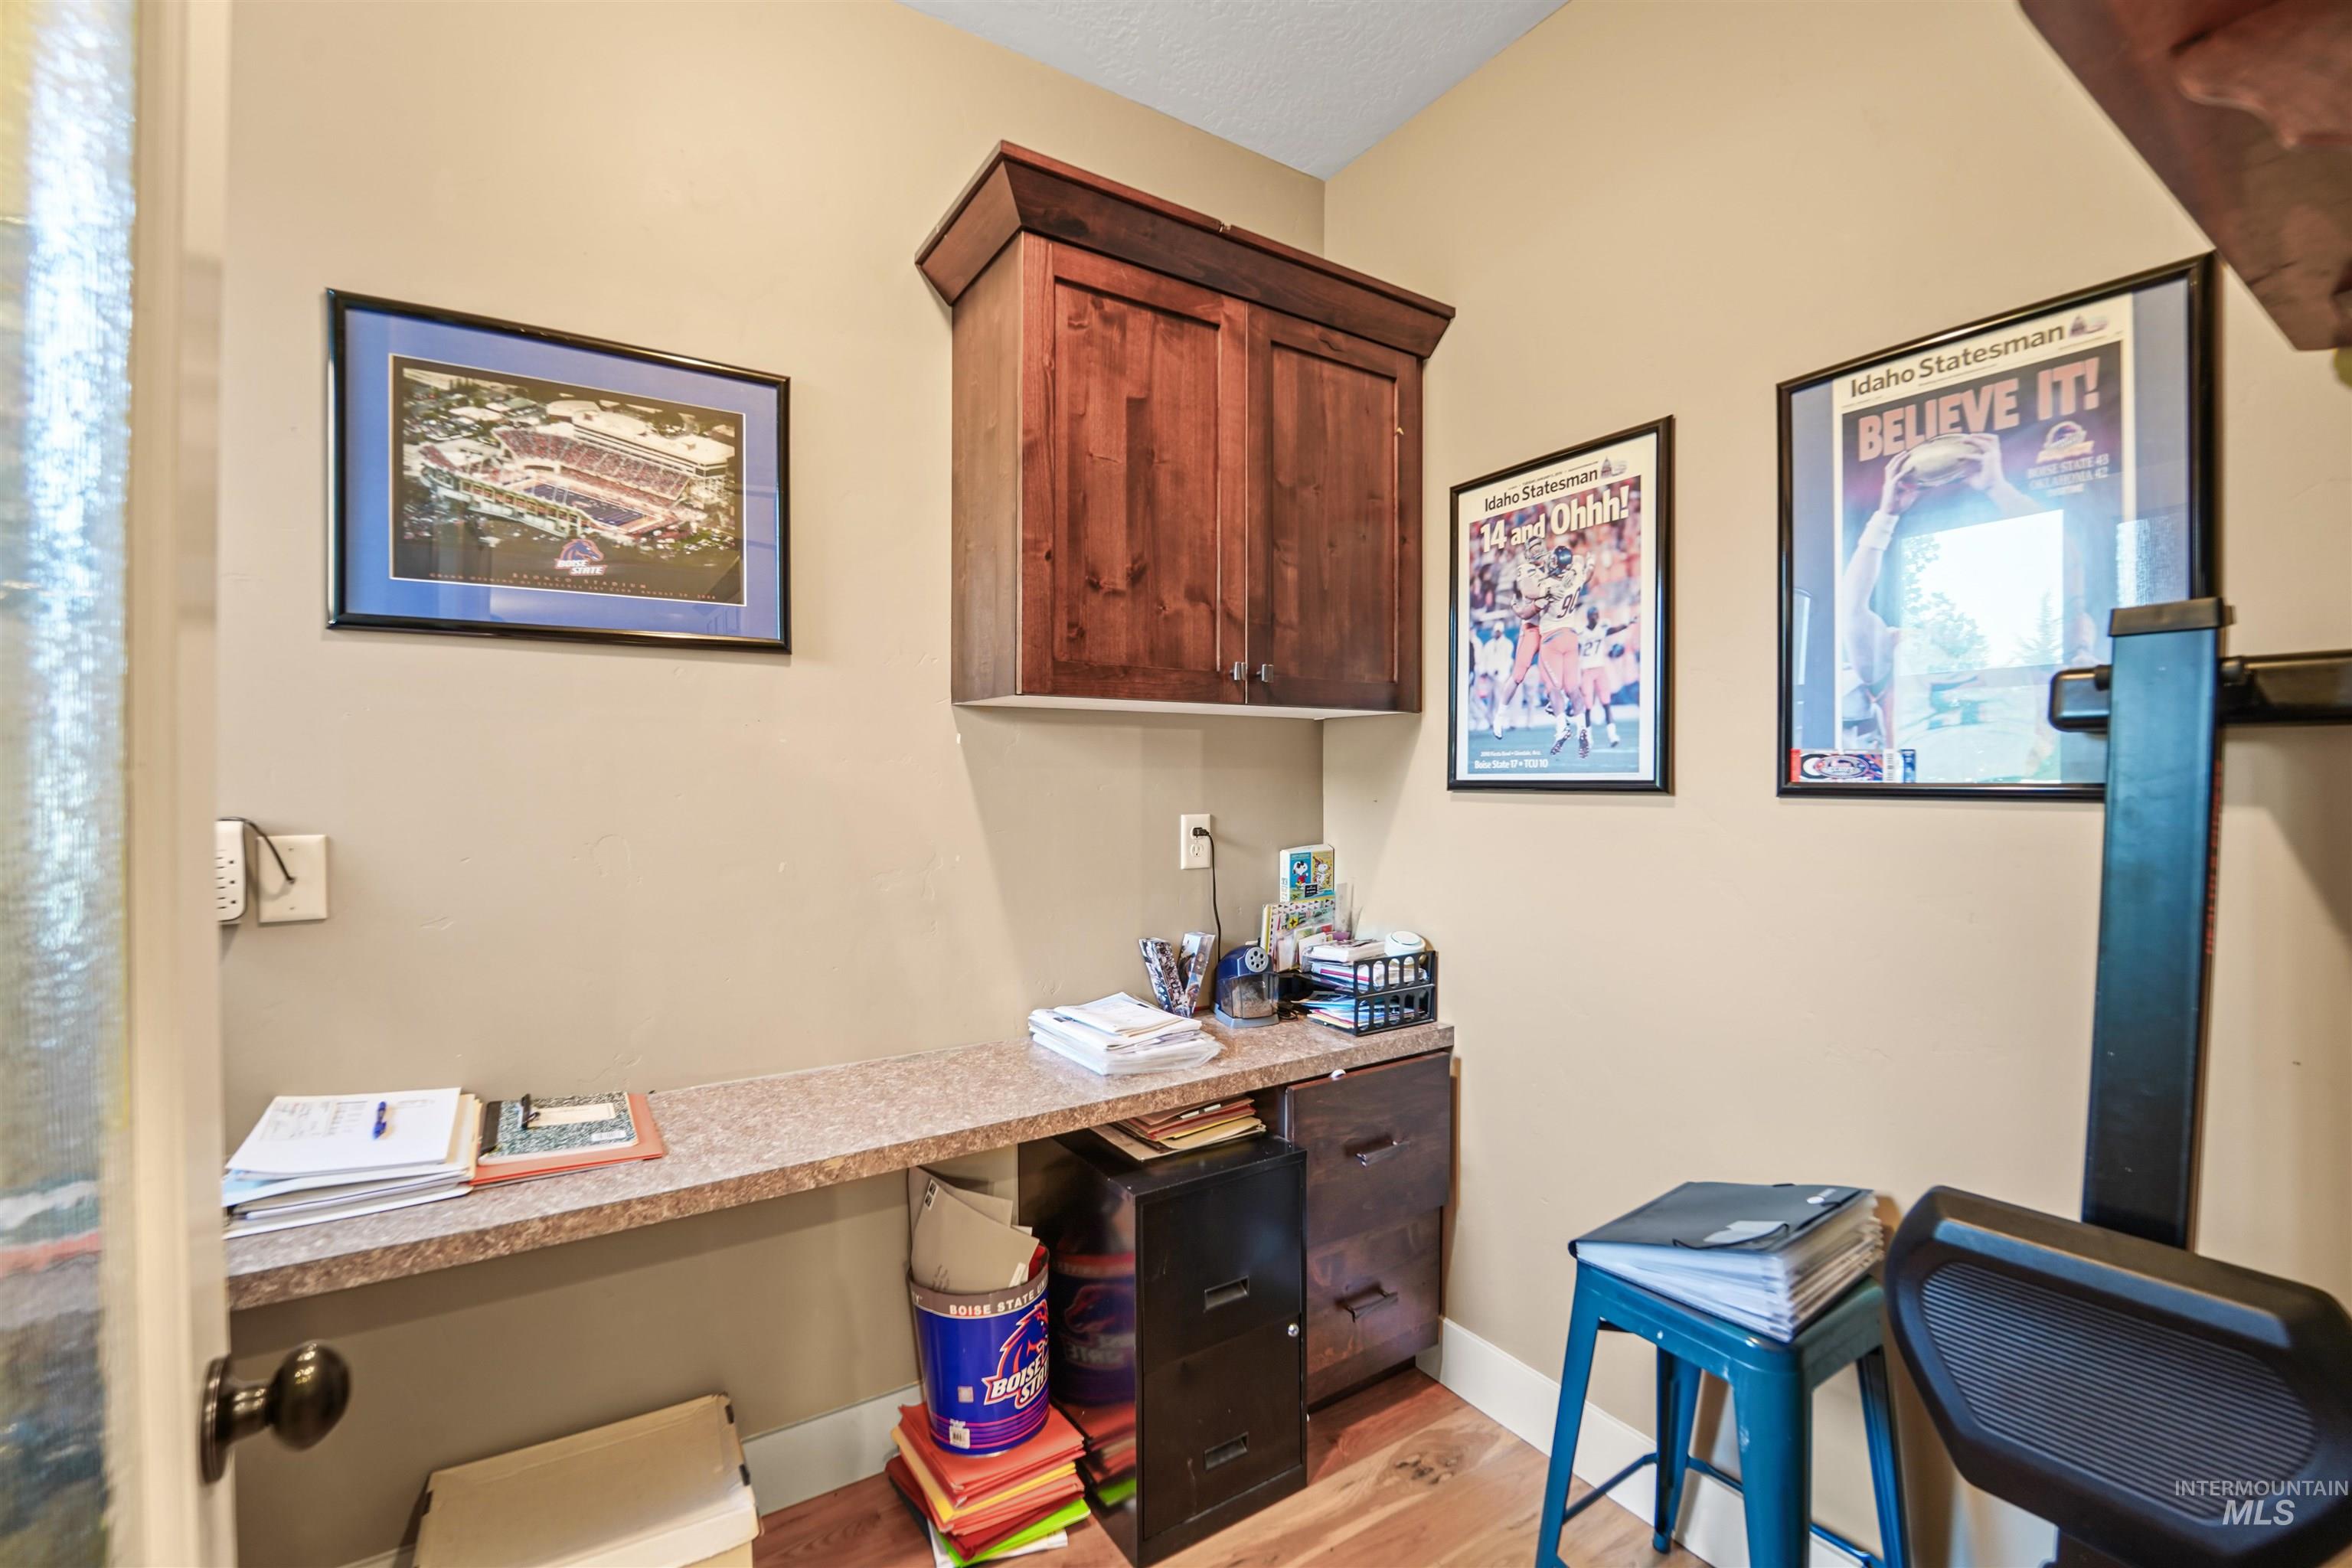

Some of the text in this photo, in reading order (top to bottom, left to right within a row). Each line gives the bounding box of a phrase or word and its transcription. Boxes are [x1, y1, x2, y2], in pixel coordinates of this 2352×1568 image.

[1851, 368, 1915, 397] Idaho
[1919, 325, 2064, 378] Statesman
[1858, 356, 2100, 462] BELIEVE IT!
[1485, 492, 1520, 512] Idaho
[1522, 469, 1598, 501] Statesman
[1480, 485, 1630, 553] 14 and Ohhh!
[1474, 759, 1548, 769] Boise State 17 TCU 10
[949, 1304, 991, 1315] BOISE
[997, 1289, 1034, 1313] STATE
[990, 1352, 1042, 1399] BOISE
[1020, 1358, 1048, 1403] STAT
